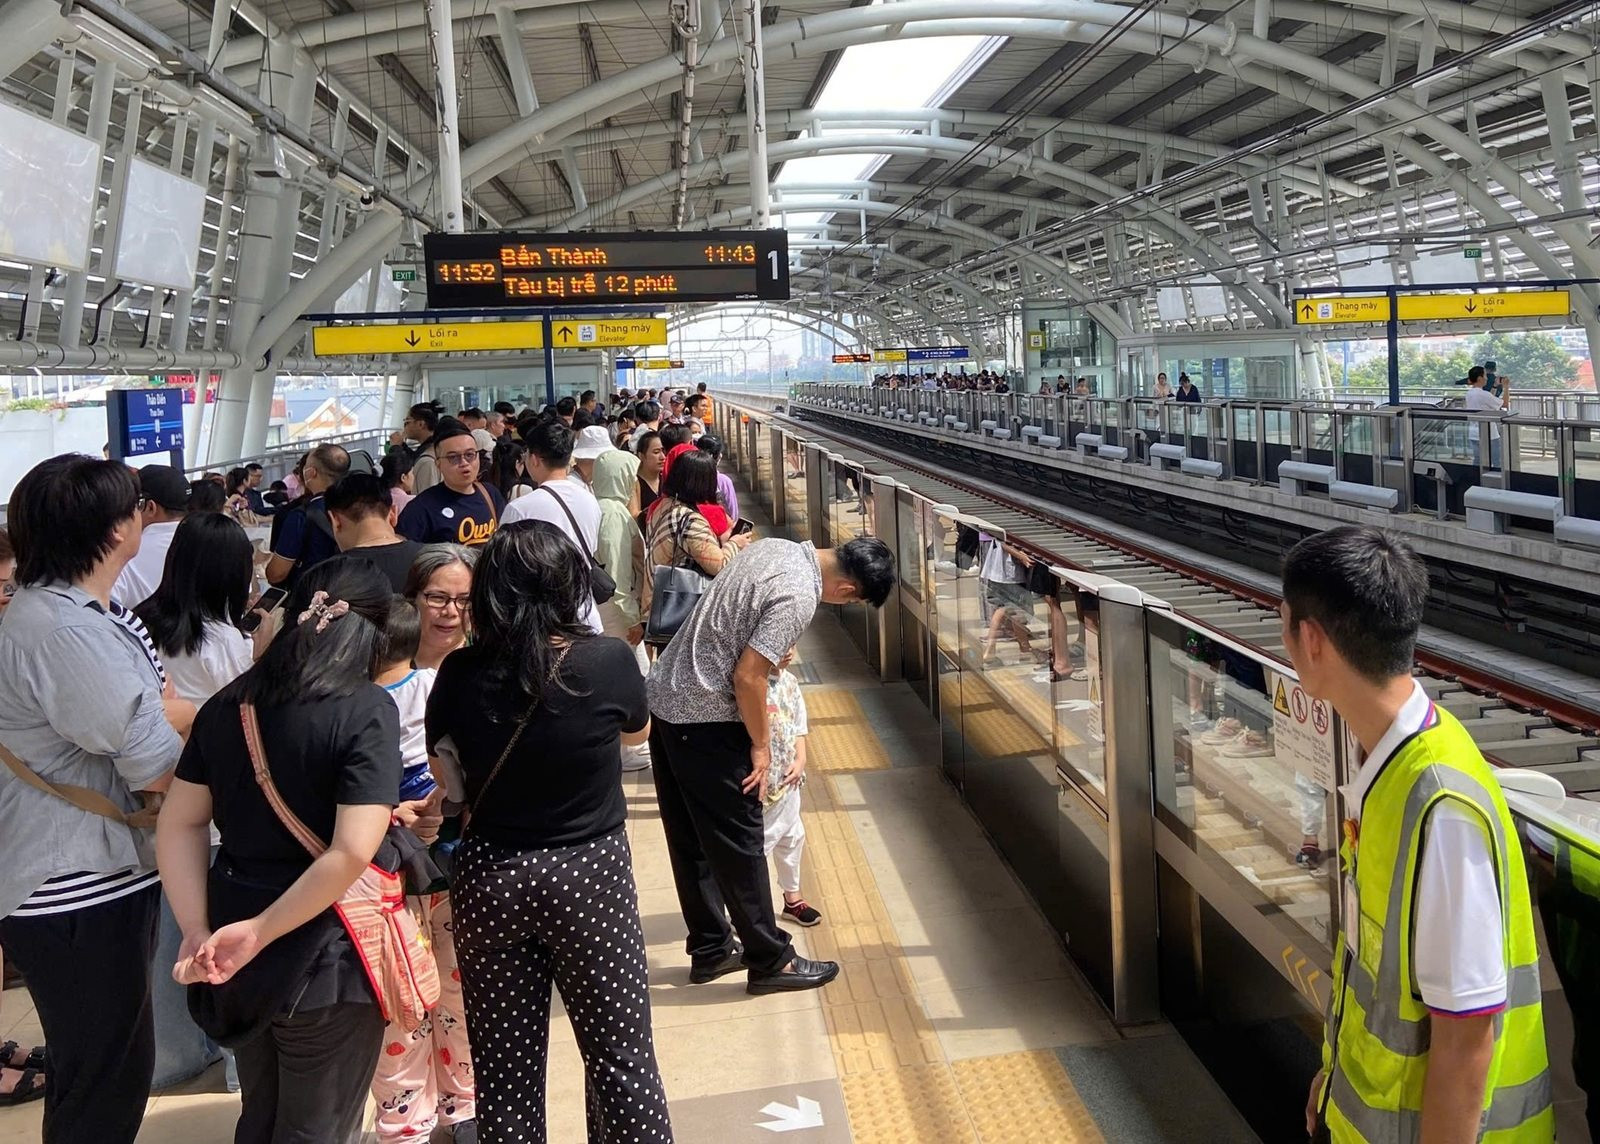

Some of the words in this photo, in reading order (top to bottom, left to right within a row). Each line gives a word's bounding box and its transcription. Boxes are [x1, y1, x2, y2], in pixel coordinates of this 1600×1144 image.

[500, 244, 542, 266] Bến
[546, 246, 608, 265] Thành
[704, 244, 756, 263] 11:43
[438, 263, 496, 281] 11:52
[767, 250, 779, 280] 1
[395, 271, 412, 280] EXIT
[502, 276, 542, 295] Tàu
[547, 276, 565, 297] bị
[570, 272, 597, 293] trễ
[604, 275, 629, 293] 12
[633, 274, 678, 295] phút
[1335, 302, 1360, 311] Thang
[429, 327, 445, 338] Lối
[599, 324, 629, 335] Thang
[631, 323, 651, 333] máy
